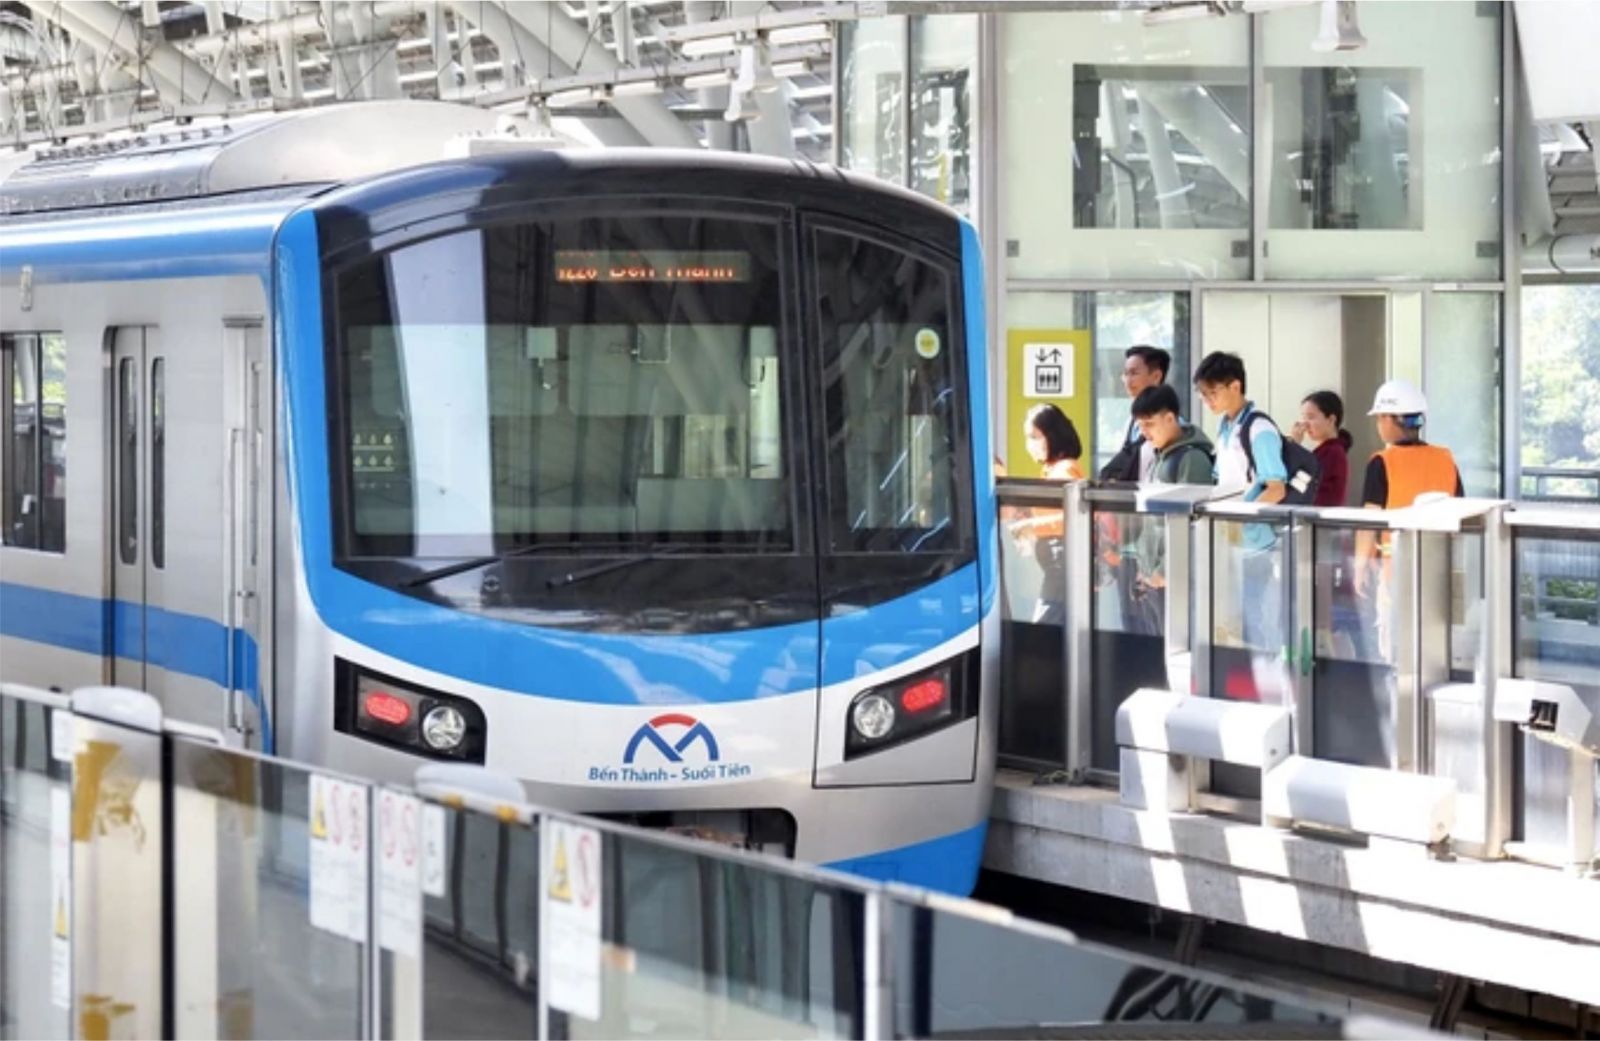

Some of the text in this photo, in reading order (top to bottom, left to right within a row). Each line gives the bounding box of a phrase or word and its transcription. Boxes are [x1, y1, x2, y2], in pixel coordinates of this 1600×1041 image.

[588, 765, 618, 781] Bến
[621, 767, 668, 782] Thành
[682, 765, 716, 780] Suối
[719, 763, 751, 778] Tiên
